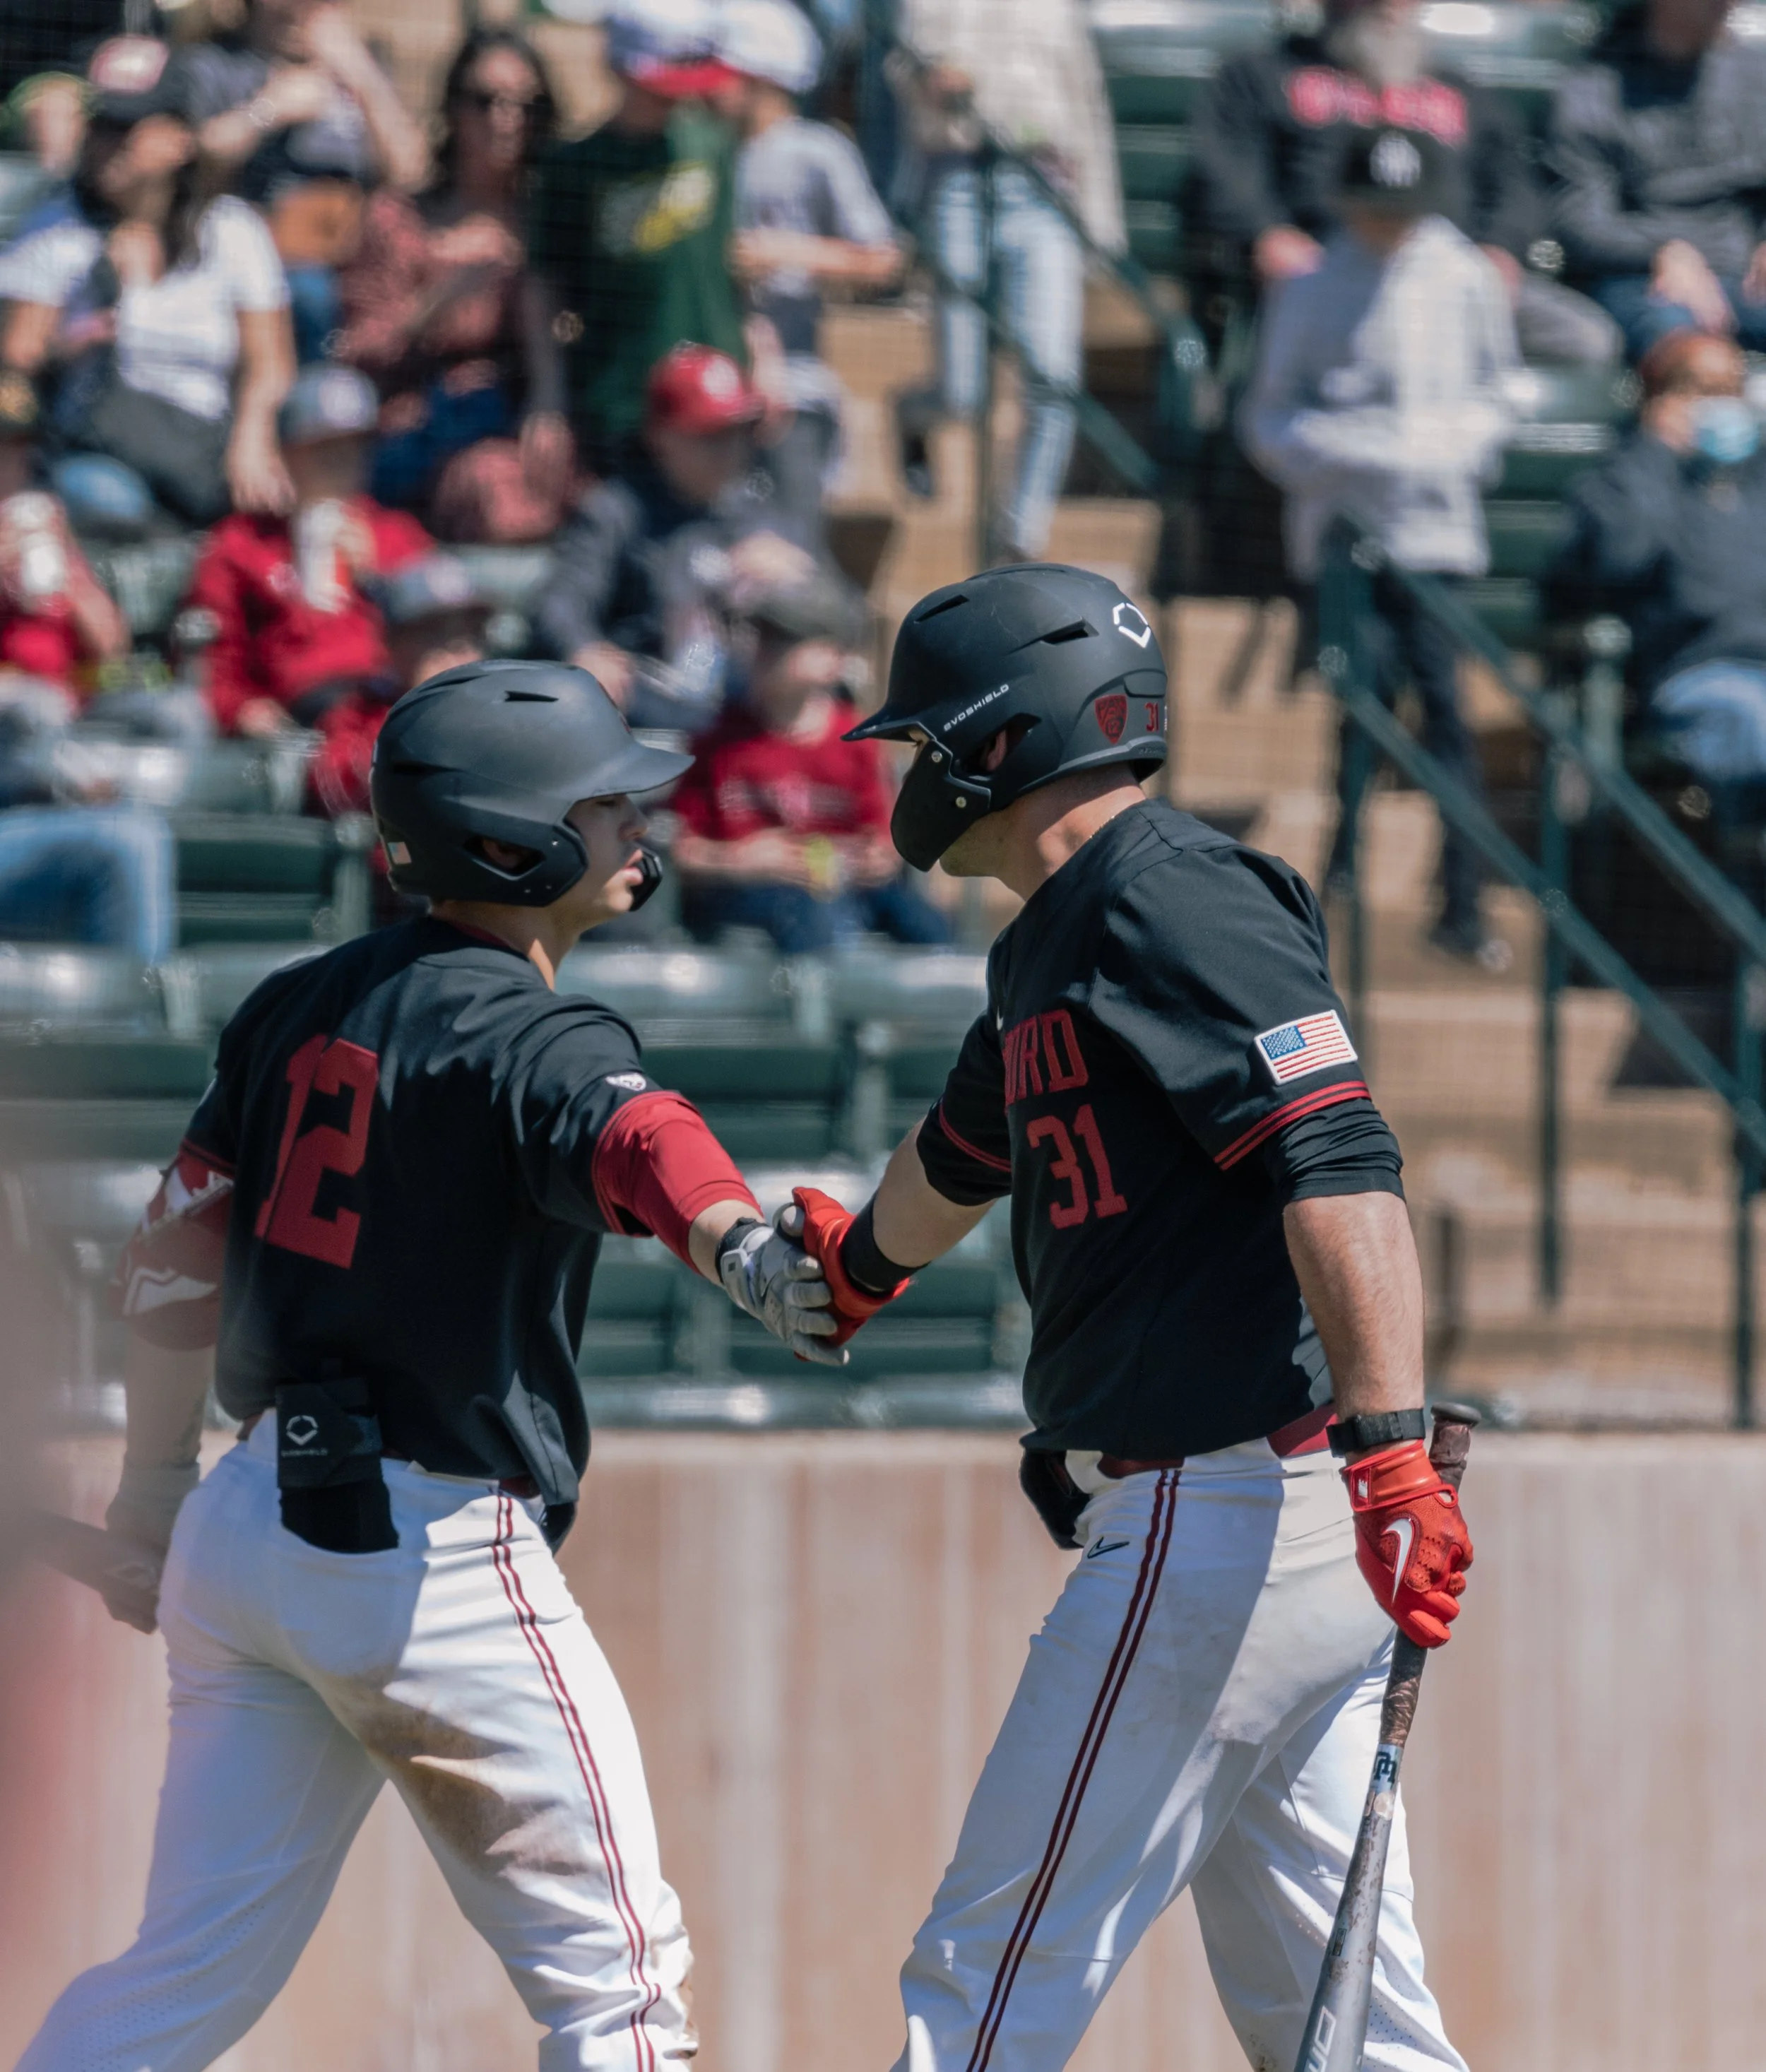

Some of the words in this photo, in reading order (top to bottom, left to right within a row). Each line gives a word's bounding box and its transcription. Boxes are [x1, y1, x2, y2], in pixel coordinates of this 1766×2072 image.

[943, 683, 1009, 732] EVOSHIELD
[1145, 702, 1159, 732] 31
[254, 1034, 379, 1269] 12
[1026, 1103, 1127, 1229] 31
